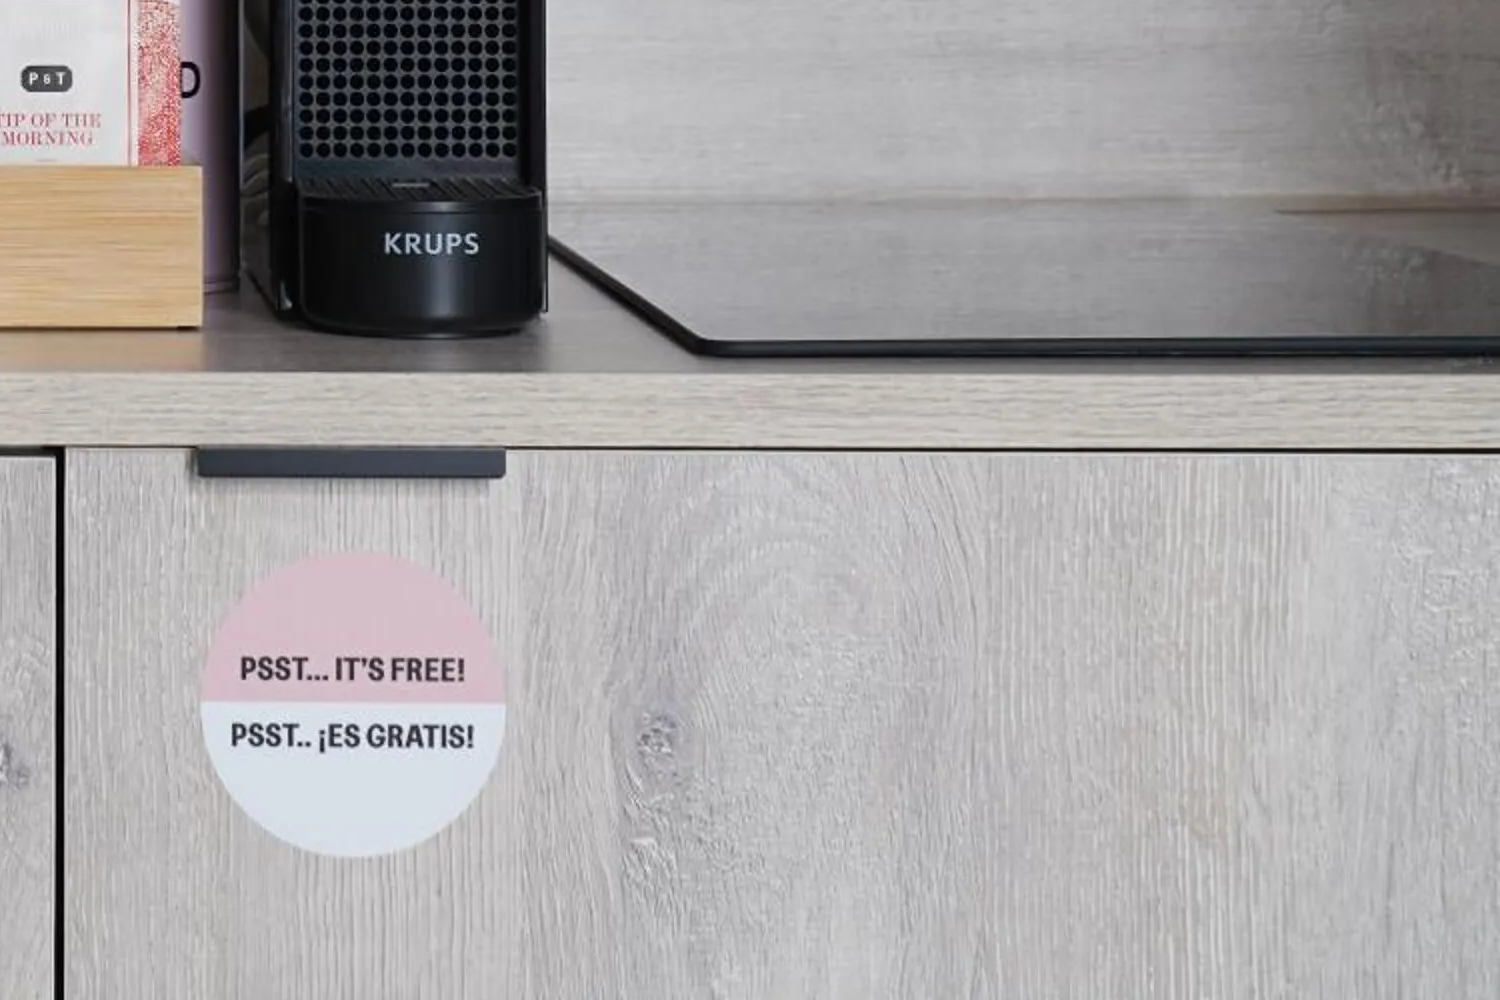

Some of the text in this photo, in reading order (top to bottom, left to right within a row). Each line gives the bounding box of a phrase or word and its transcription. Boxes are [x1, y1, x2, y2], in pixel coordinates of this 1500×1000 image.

[30, 112, 58, 128] OF
[61, 112, 102, 128] THE
[2, 130, 95, 146] MORNING
[383, 231, 480, 255] KRUPS
[240, 655, 466, 683] PSST... IT'S FREE!
[230, 722, 475, 754] PSST.. ¡ES GRATIS!
